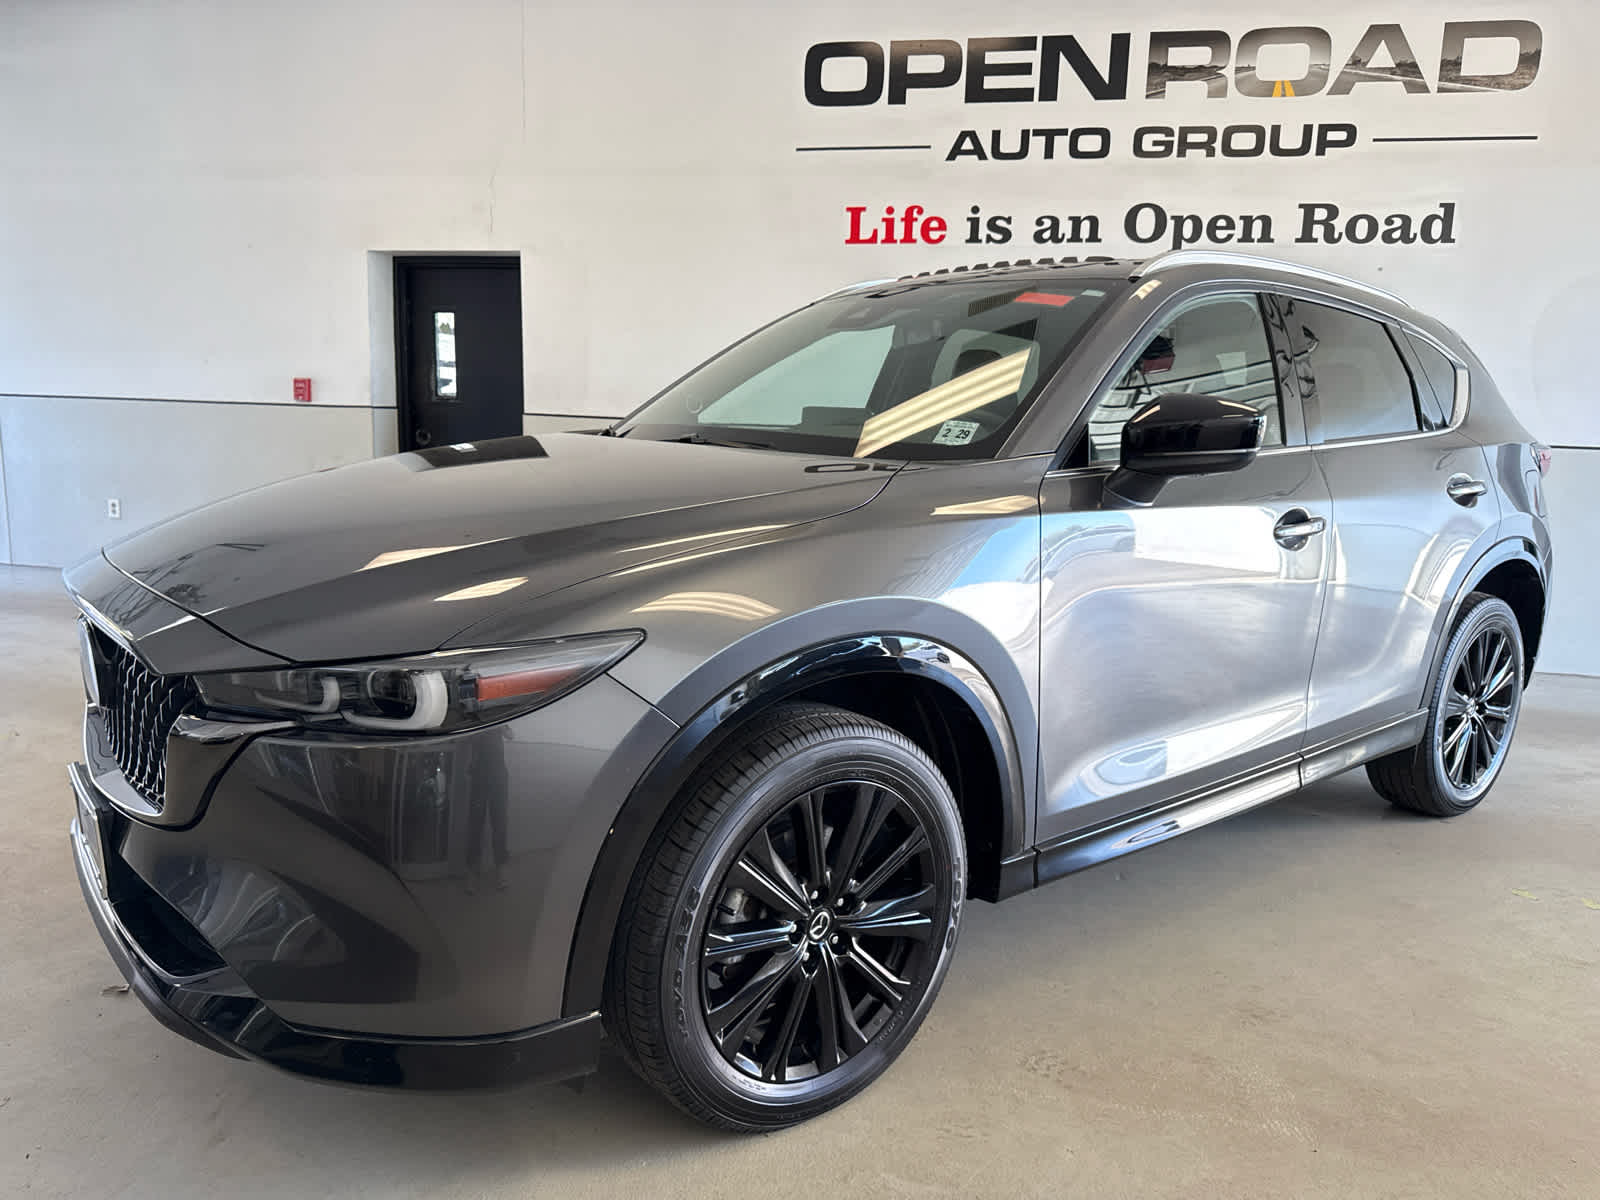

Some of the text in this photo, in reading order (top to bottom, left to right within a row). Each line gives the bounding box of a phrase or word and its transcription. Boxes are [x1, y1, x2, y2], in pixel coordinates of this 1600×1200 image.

[804, 19, 1542, 107] OPEN ROAD
[945, 123, 1358, 161] AUTO GROUP
[845, 202, 1456, 250] Life is an Open Road
[942, 428, 970, 439] 2 29
